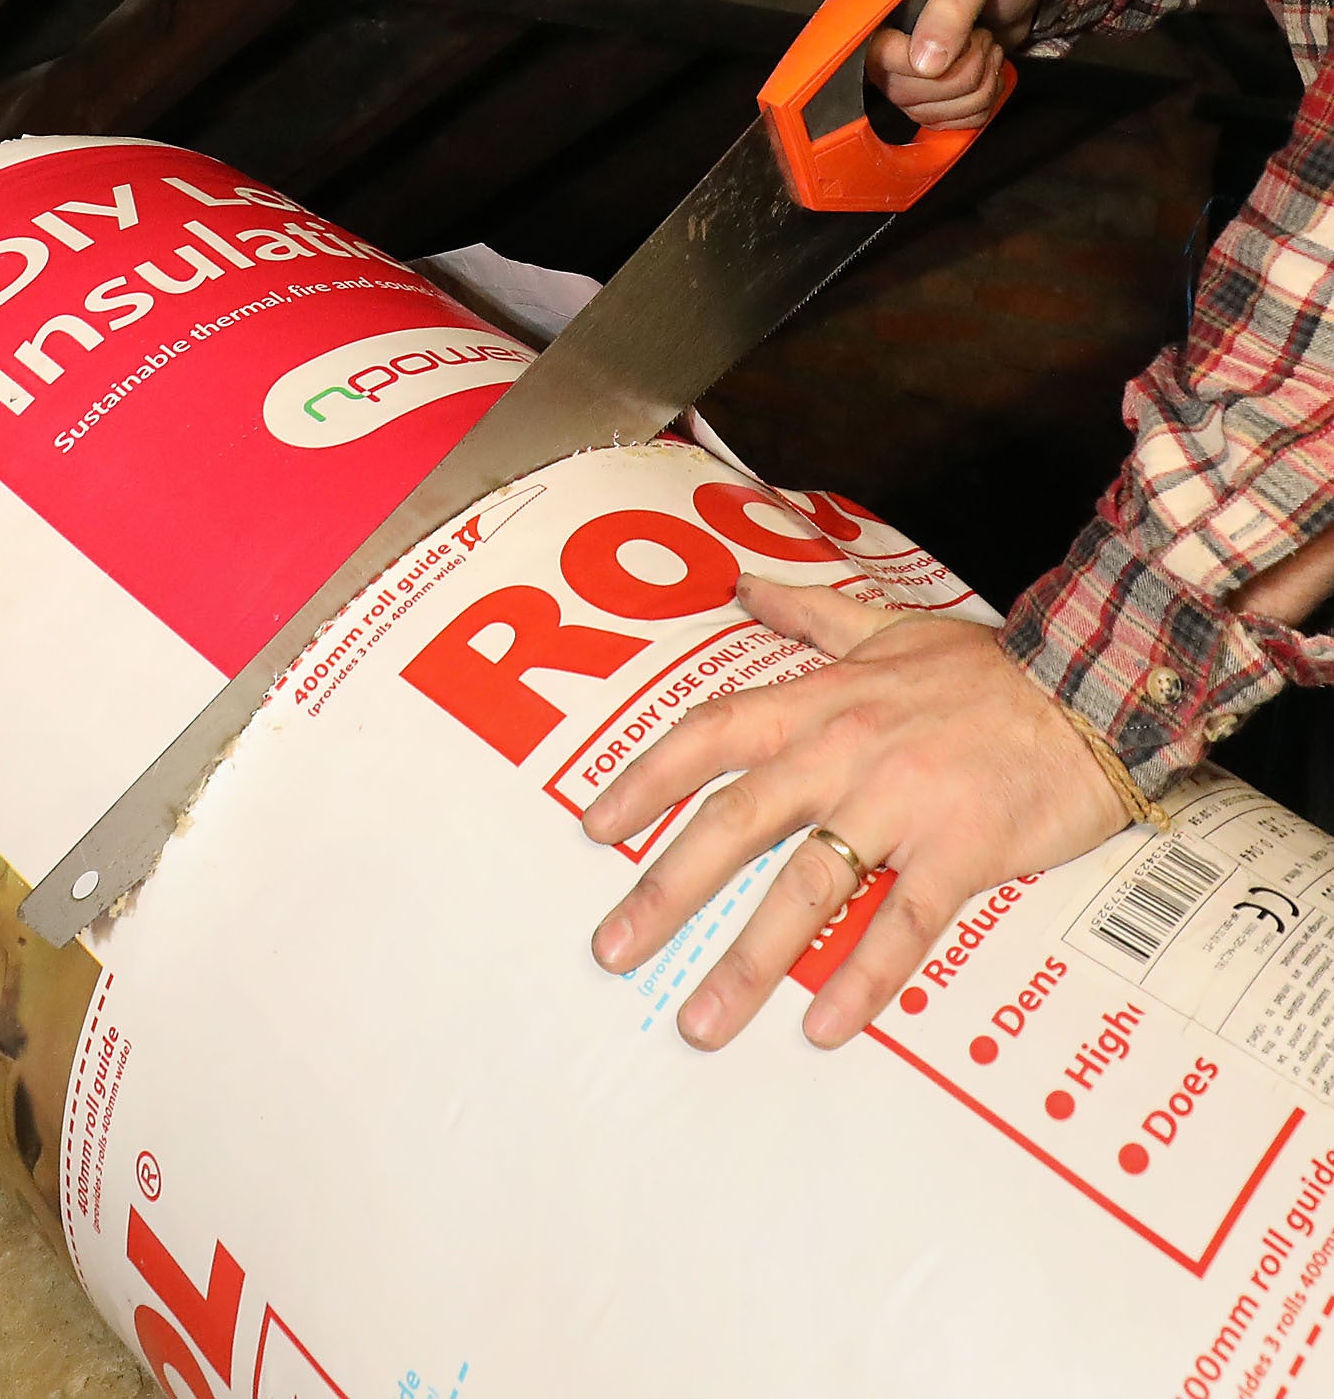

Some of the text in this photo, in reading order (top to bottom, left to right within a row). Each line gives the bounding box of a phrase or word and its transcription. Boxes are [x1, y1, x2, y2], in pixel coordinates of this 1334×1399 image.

[53, 338, 191, 454] Sustainable
[189, 290, 293, 341] thermal,
[288, 280, 332, 299] fire
[332, 276, 375, 291] and
[294, 542, 452, 705] 400mm roll guide
[307, 656, 360, 718] (provides
[366, 621, 393, 649] rolls
[391, 580, 435, 623] 400mm
[433, 553, 467, 585] wide)
[581, 739, 631, 788] FOR
[622, 704, 663, 744] DIY
[657, 672, 704, 709] USE
[697, 640, 758, 678] ONLY:
[1089, 880, 1132, 926] 217325
[1133, 841, 1171, 875] 013423
[921, 886, 1023, 989] Reduce
[991, 954, 1069, 1038] Dens
[115, 1038, 133, 1081] wide)
[1063, 1001, 1147, 1092] High
[77, 1026, 120, 1218] 400mm roll guide
[1140, 1055, 1220, 1148] Does
[1250, 1228, 1294, 1293] roll
[1276, 1291, 1308, 1339] rolls
